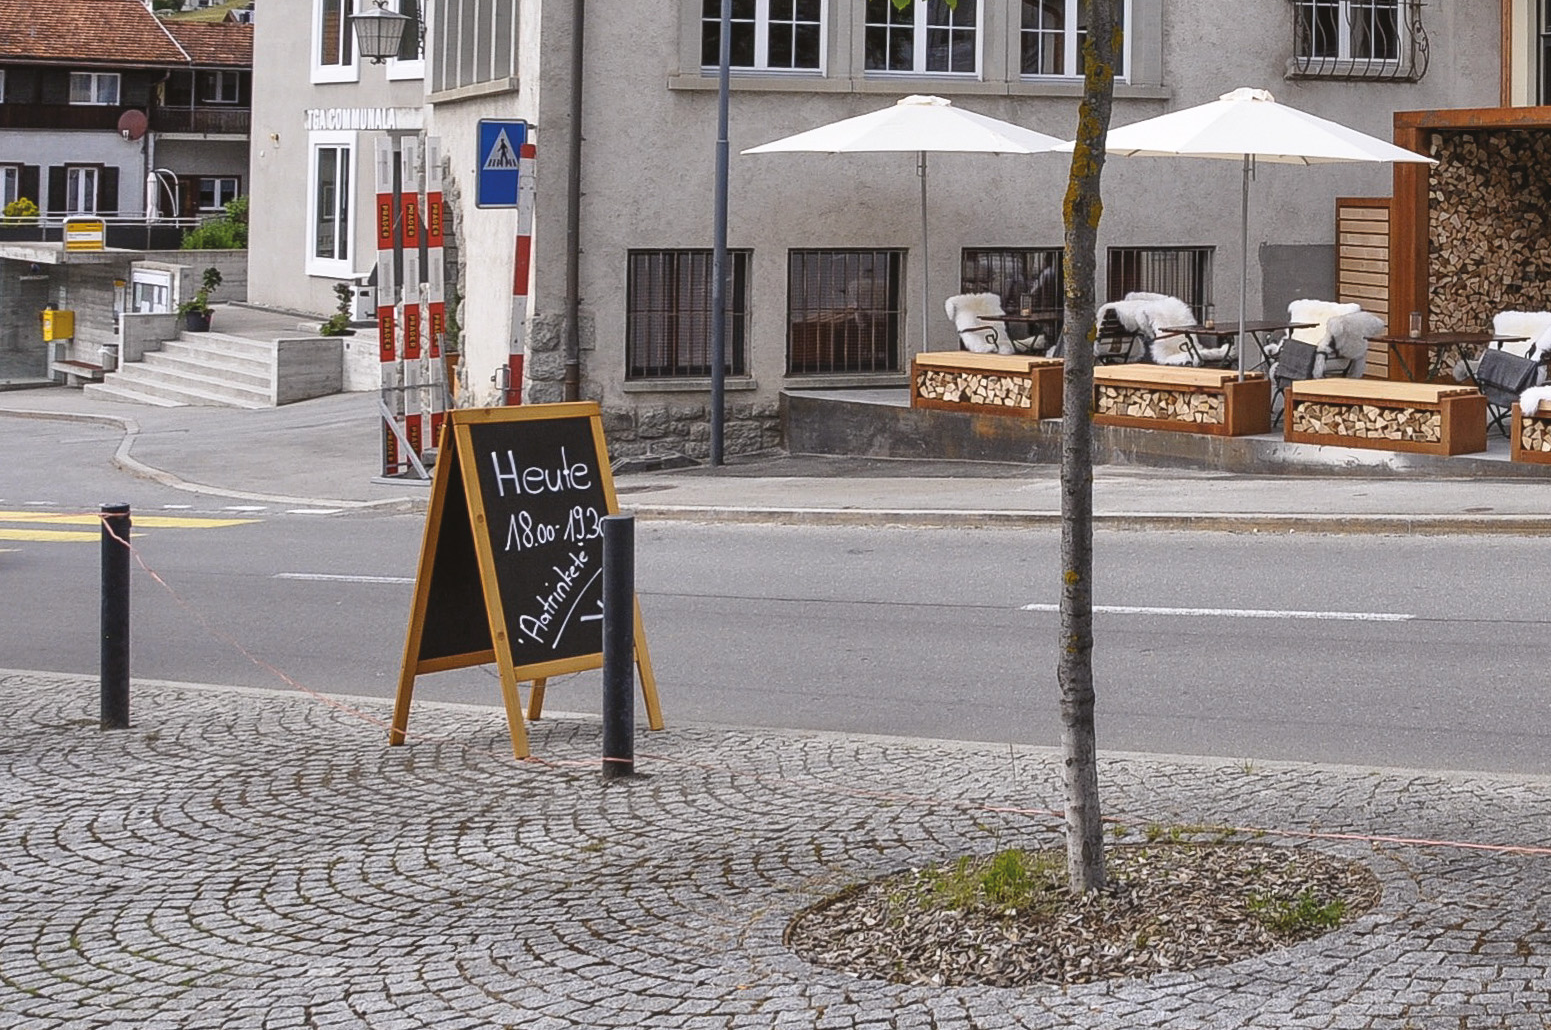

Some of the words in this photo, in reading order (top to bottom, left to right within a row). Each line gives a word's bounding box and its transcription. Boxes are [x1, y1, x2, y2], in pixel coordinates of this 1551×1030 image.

[327, 108, 396, 130] COMMUNALA
[382, 205, 390, 237] PRADER
[491, 446, 592, 497] Heute
